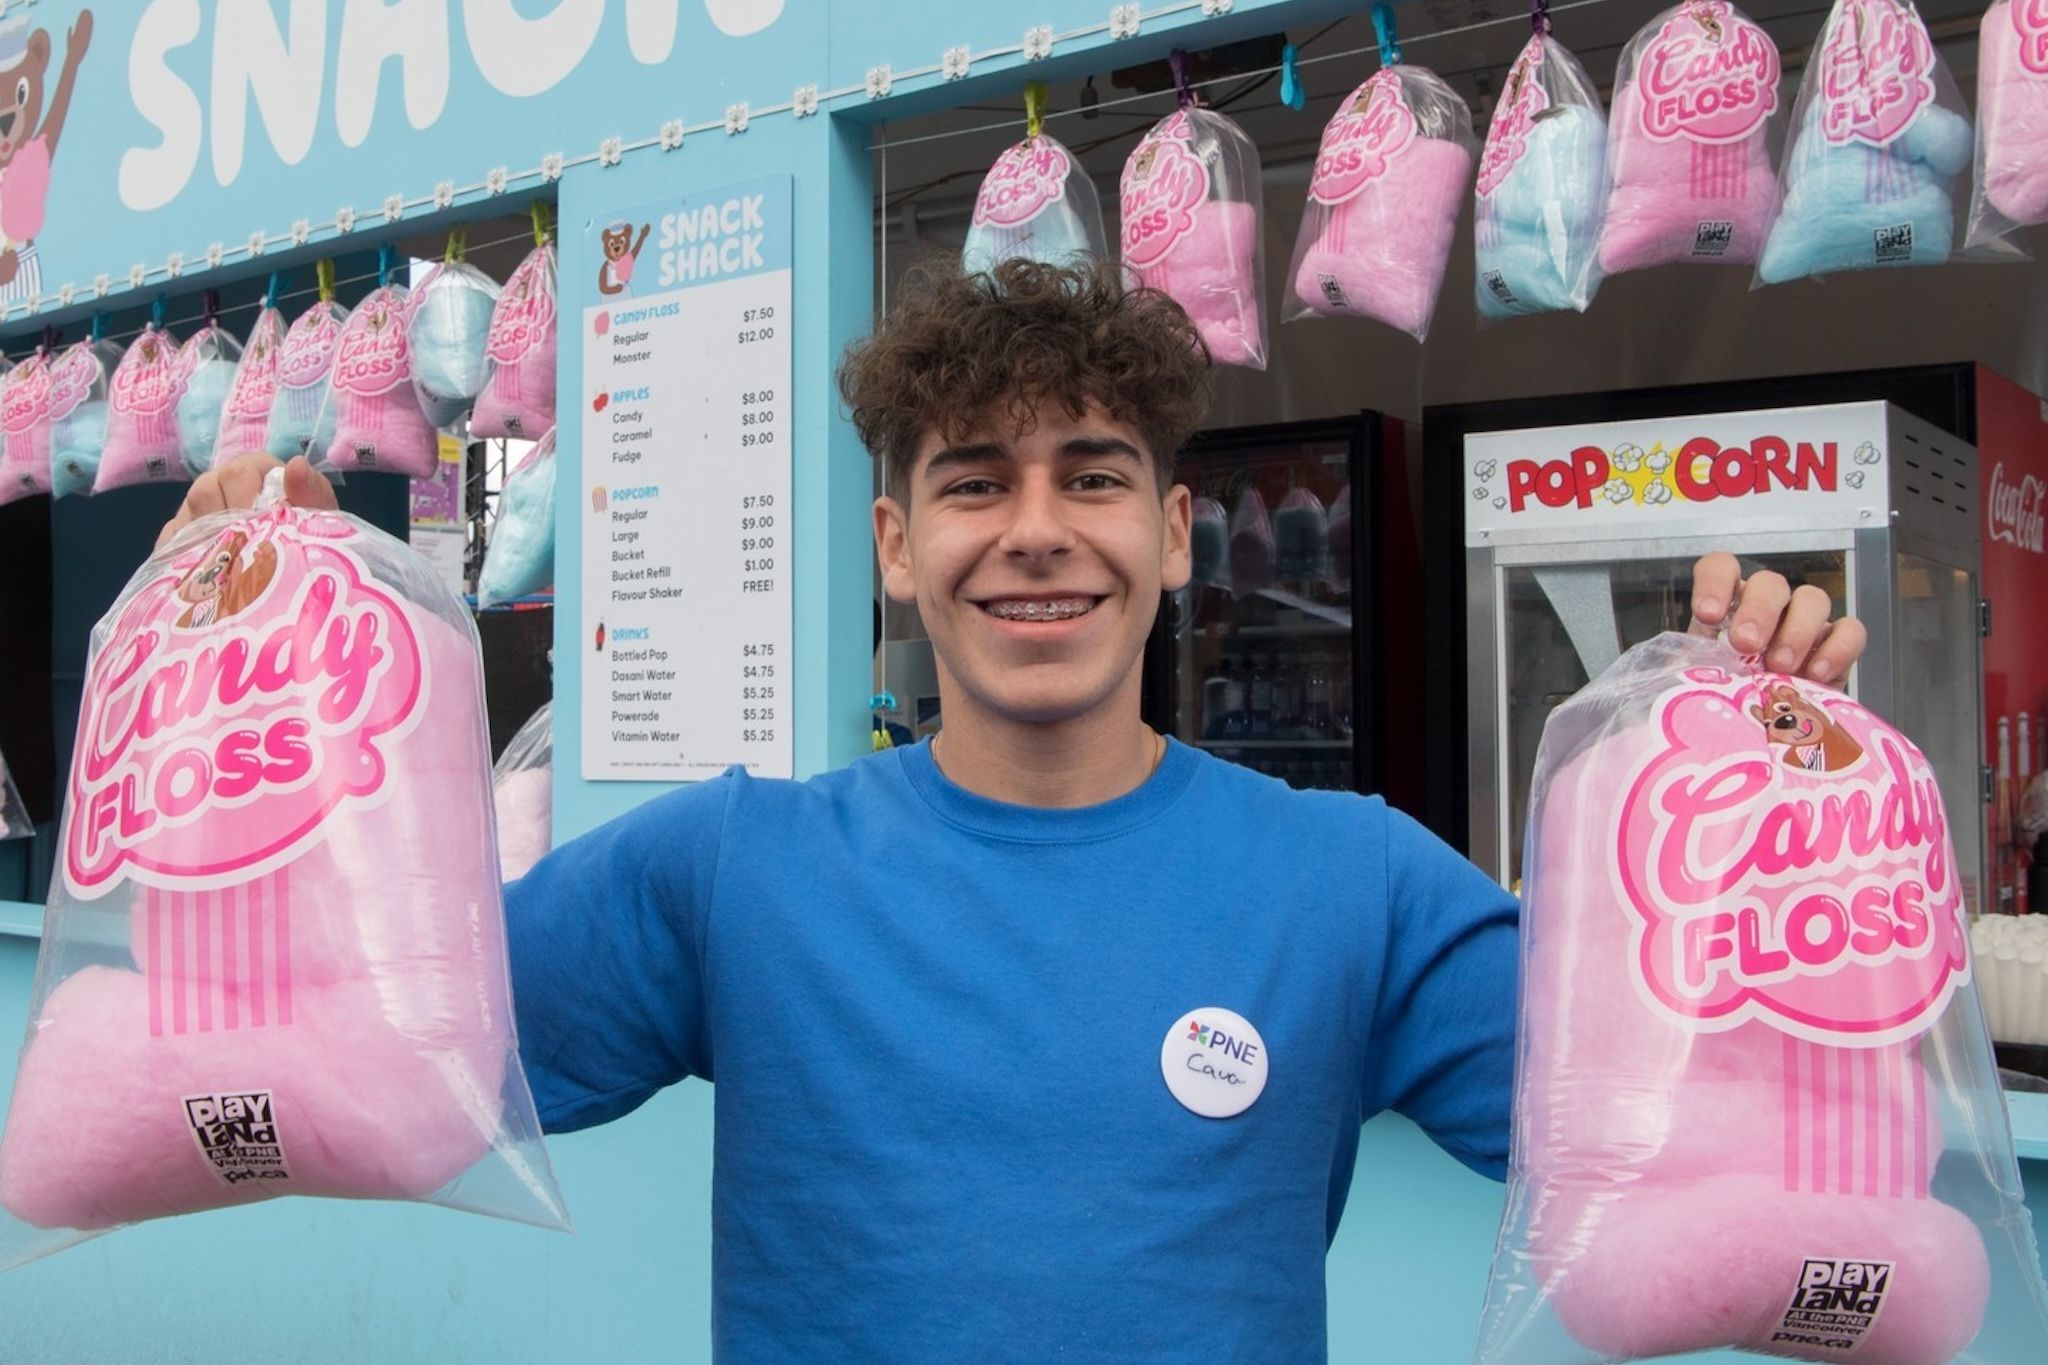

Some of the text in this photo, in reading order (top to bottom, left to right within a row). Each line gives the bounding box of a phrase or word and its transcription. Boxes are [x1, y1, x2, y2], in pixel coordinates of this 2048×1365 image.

[1652, 27, 1768, 95] Candy
[1658, 78, 1755, 126] FLOSS
[1121, 155, 1190, 218] andy
[659, 194, 764, 249] SNACK
[658, 233, 764, 287] SHACK
[648, 302, 680, 319] FLOSS
[743, 307, 774, 323] $7.50
[613, 330, 649, 346] Regular
[738, 327, 774, 344] $12.00
[613, 350, 652, 365] Monster
[339, 358, 393, 382] FLOSS
[742, 390, 774, 405] $8.00
[613, 411, 643, 424] Candy
[742, 411, 774, 426] $8.00
[612, 428, 652, 443] Caramel
[742, 432, 774, 447] $9.00
[612, 451, 642, 463] Fudge
[1507, 436, 1838, 513] POP CORN
[743, 495, 774, 509] $7.50
[612, 509, 648, 522] Regular
[742, 516, 774, 530] $9.00
[612, 530, 639, 543] Large
[742, 537, 774, 551] $9.00
[612, 549, 645, 562] Bucket
[744, 558, 774, 572] $1.00
[612, 567, 671, 582] Bucket Refill
[743, 579, 774, 593] FREE!
[612, 586, 683, 602] Flavour Shaker
[612, 649, 668, 662] Bottled Pop
[743, 644, 774, 657] $4.75
[86, 573, 384, 782] Candy
[612, 669, 676, 682] Dasani Water
[743, 666, 774, 678] $4.75
[612, 690, 672, 702] Smart Water
[743, 687, 774, 699] $5.25
[612, 710, 660, 722] Powerade
[743, 709, 774, 721] $5.25
[612, 730, 680, 742] Vitamin Water
[743, 730, 774, 742] $5.25
[86, 717, 314, 859] FLOSS
[1659, 738, 1945, 906] Candy
[1683, 879, 1929, 988] FLOSS
[1209, 1030, 1258, 1066] PNE
[1783, 1319, 1865, 1335] Vancouver
[1810, 1312, 1833, 1323] the
[1835, 1315, 1869, 1327] PNE
[1771, 1332, 1854, 1349] pne.ca
